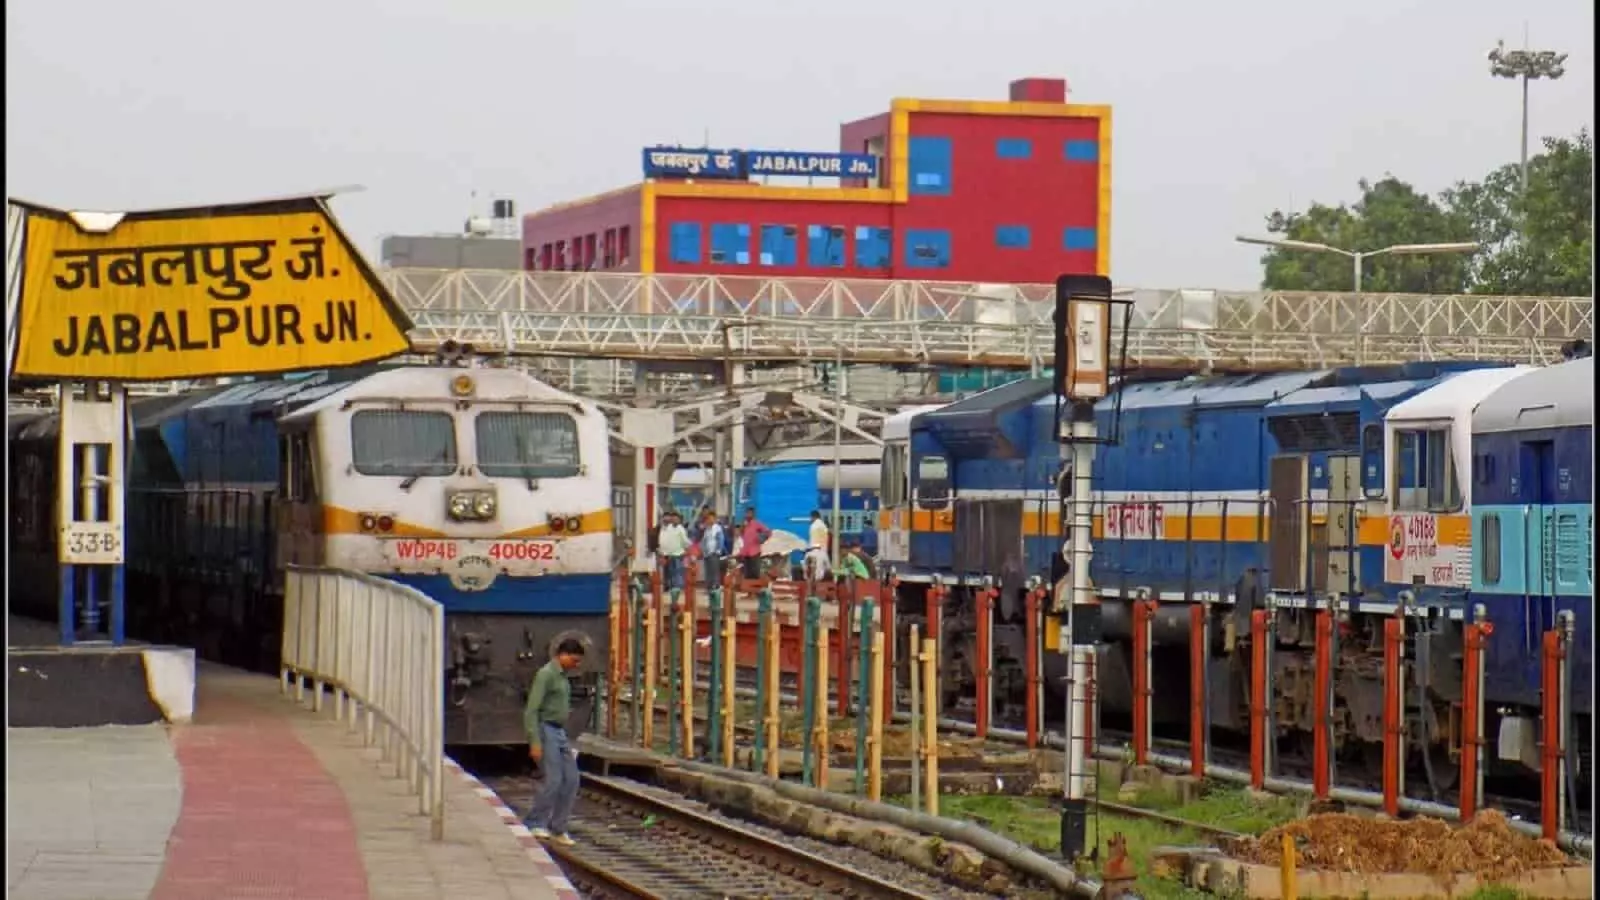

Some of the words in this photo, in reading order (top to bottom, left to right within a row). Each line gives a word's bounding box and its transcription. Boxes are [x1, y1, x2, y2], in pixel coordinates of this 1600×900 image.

[752, 155, 841, 173] JABALPUR
[848, 160, 873, 173] Jn.
[53, 239, 277, 301] जबलपुर
[285, 224, 341, 281] जं.
[53, 303, 305, 357] JABALPUR
[313, 300, 373, 344] JN.
[397, 541, 457, 559] WDP4B
[488, 543, 553, 560] 40062
